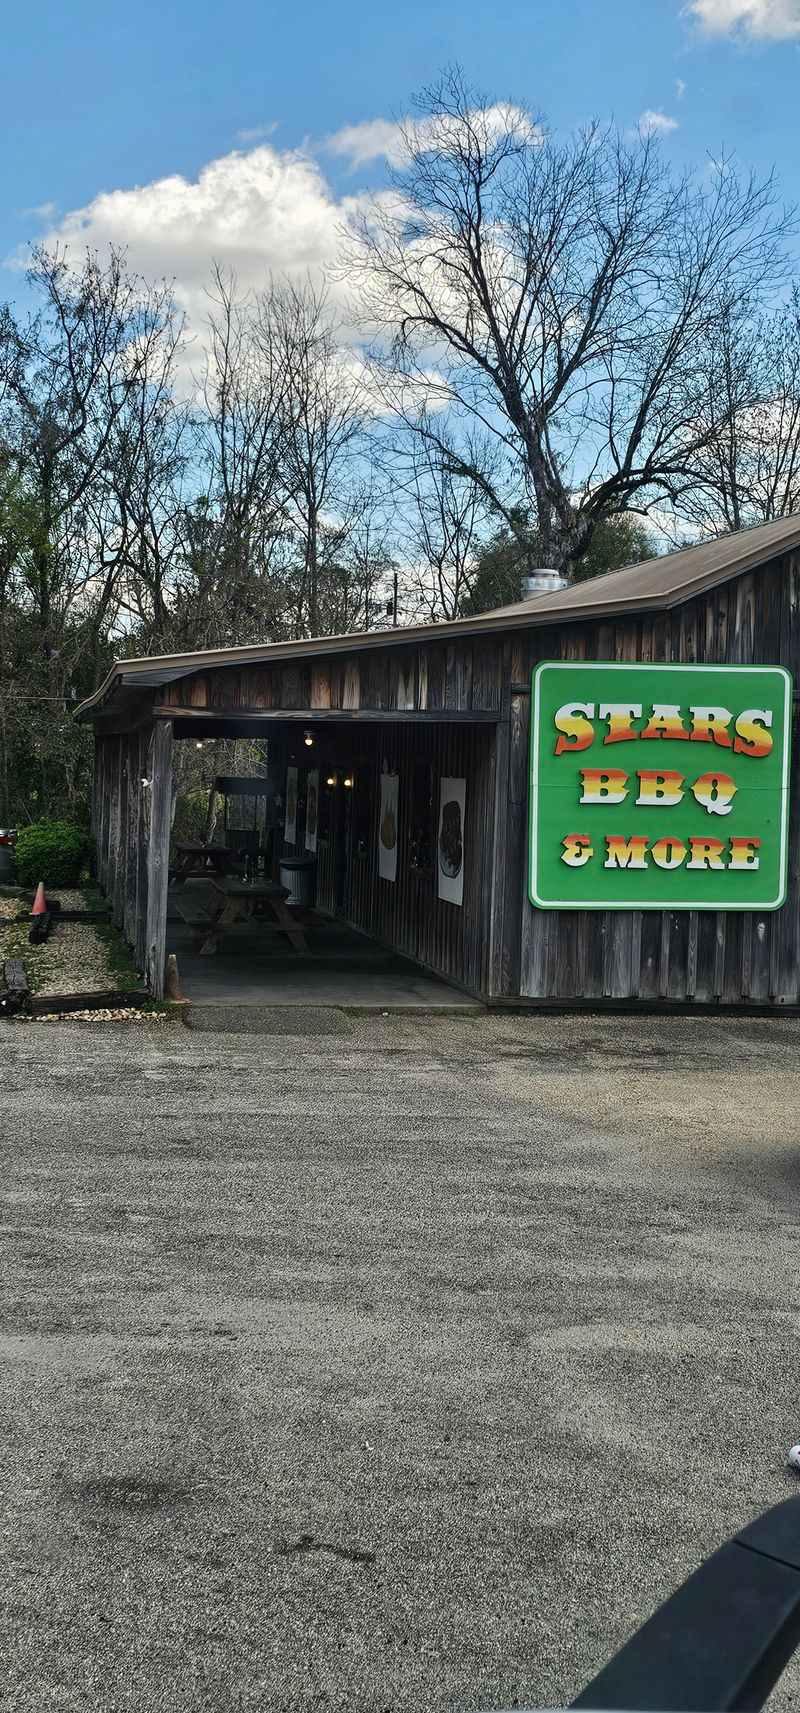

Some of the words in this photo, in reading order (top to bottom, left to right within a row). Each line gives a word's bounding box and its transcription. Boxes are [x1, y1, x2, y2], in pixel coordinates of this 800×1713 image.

[554, 702, 774, 758] STARS
[579, 768, 738, 816] BBQ
[560, 833, 594, 868] &
[604, 836, 761, 870] MORE
